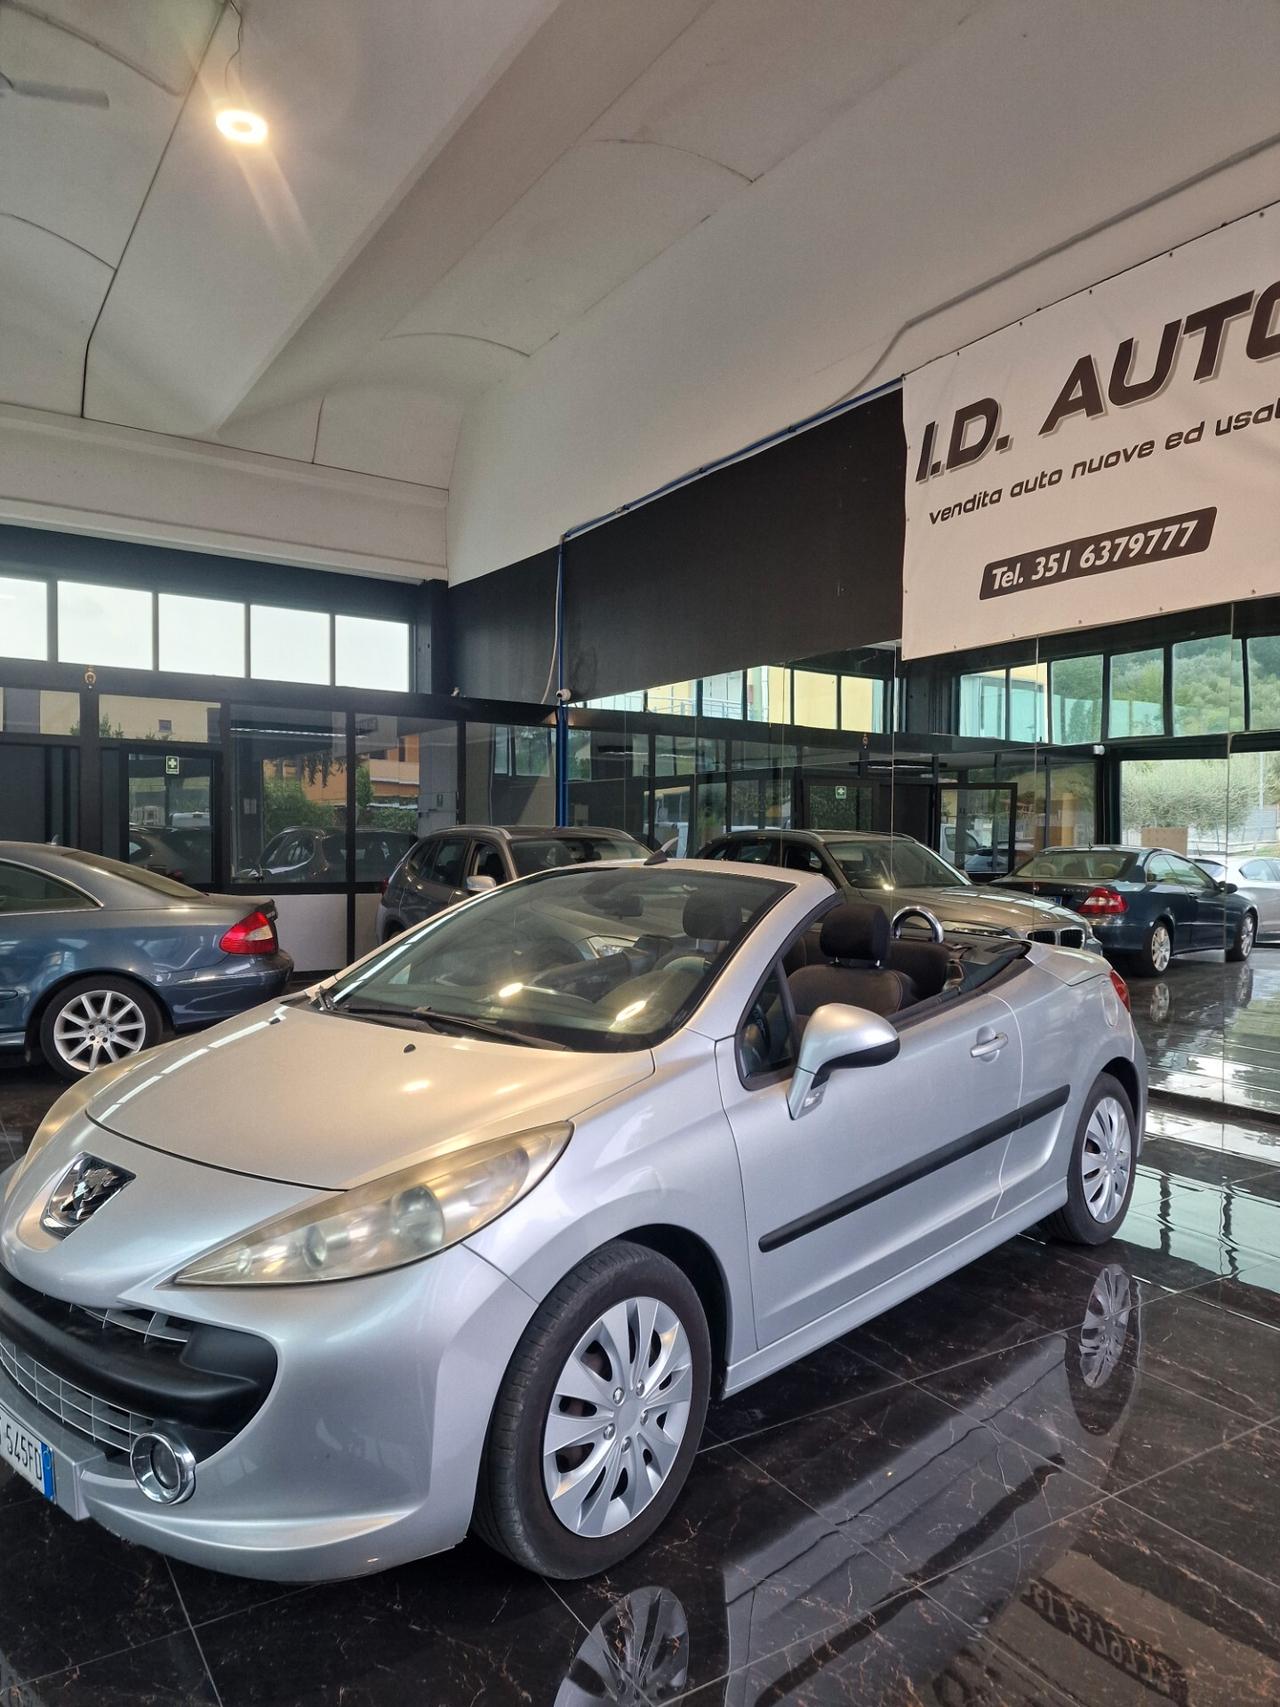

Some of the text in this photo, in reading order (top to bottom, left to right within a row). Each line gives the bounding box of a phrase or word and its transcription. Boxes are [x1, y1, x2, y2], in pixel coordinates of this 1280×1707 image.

[915, 397, 1013, 484] I.D.
[929, 488, 1003, 524] vendita
[1010, 469, 1063, 498] auto
[1071, 440, 1154, 479] nuove
[1165, 421, 1205, 450] ed
[992, 520, 1199, 589] Tel. 351 6379777
